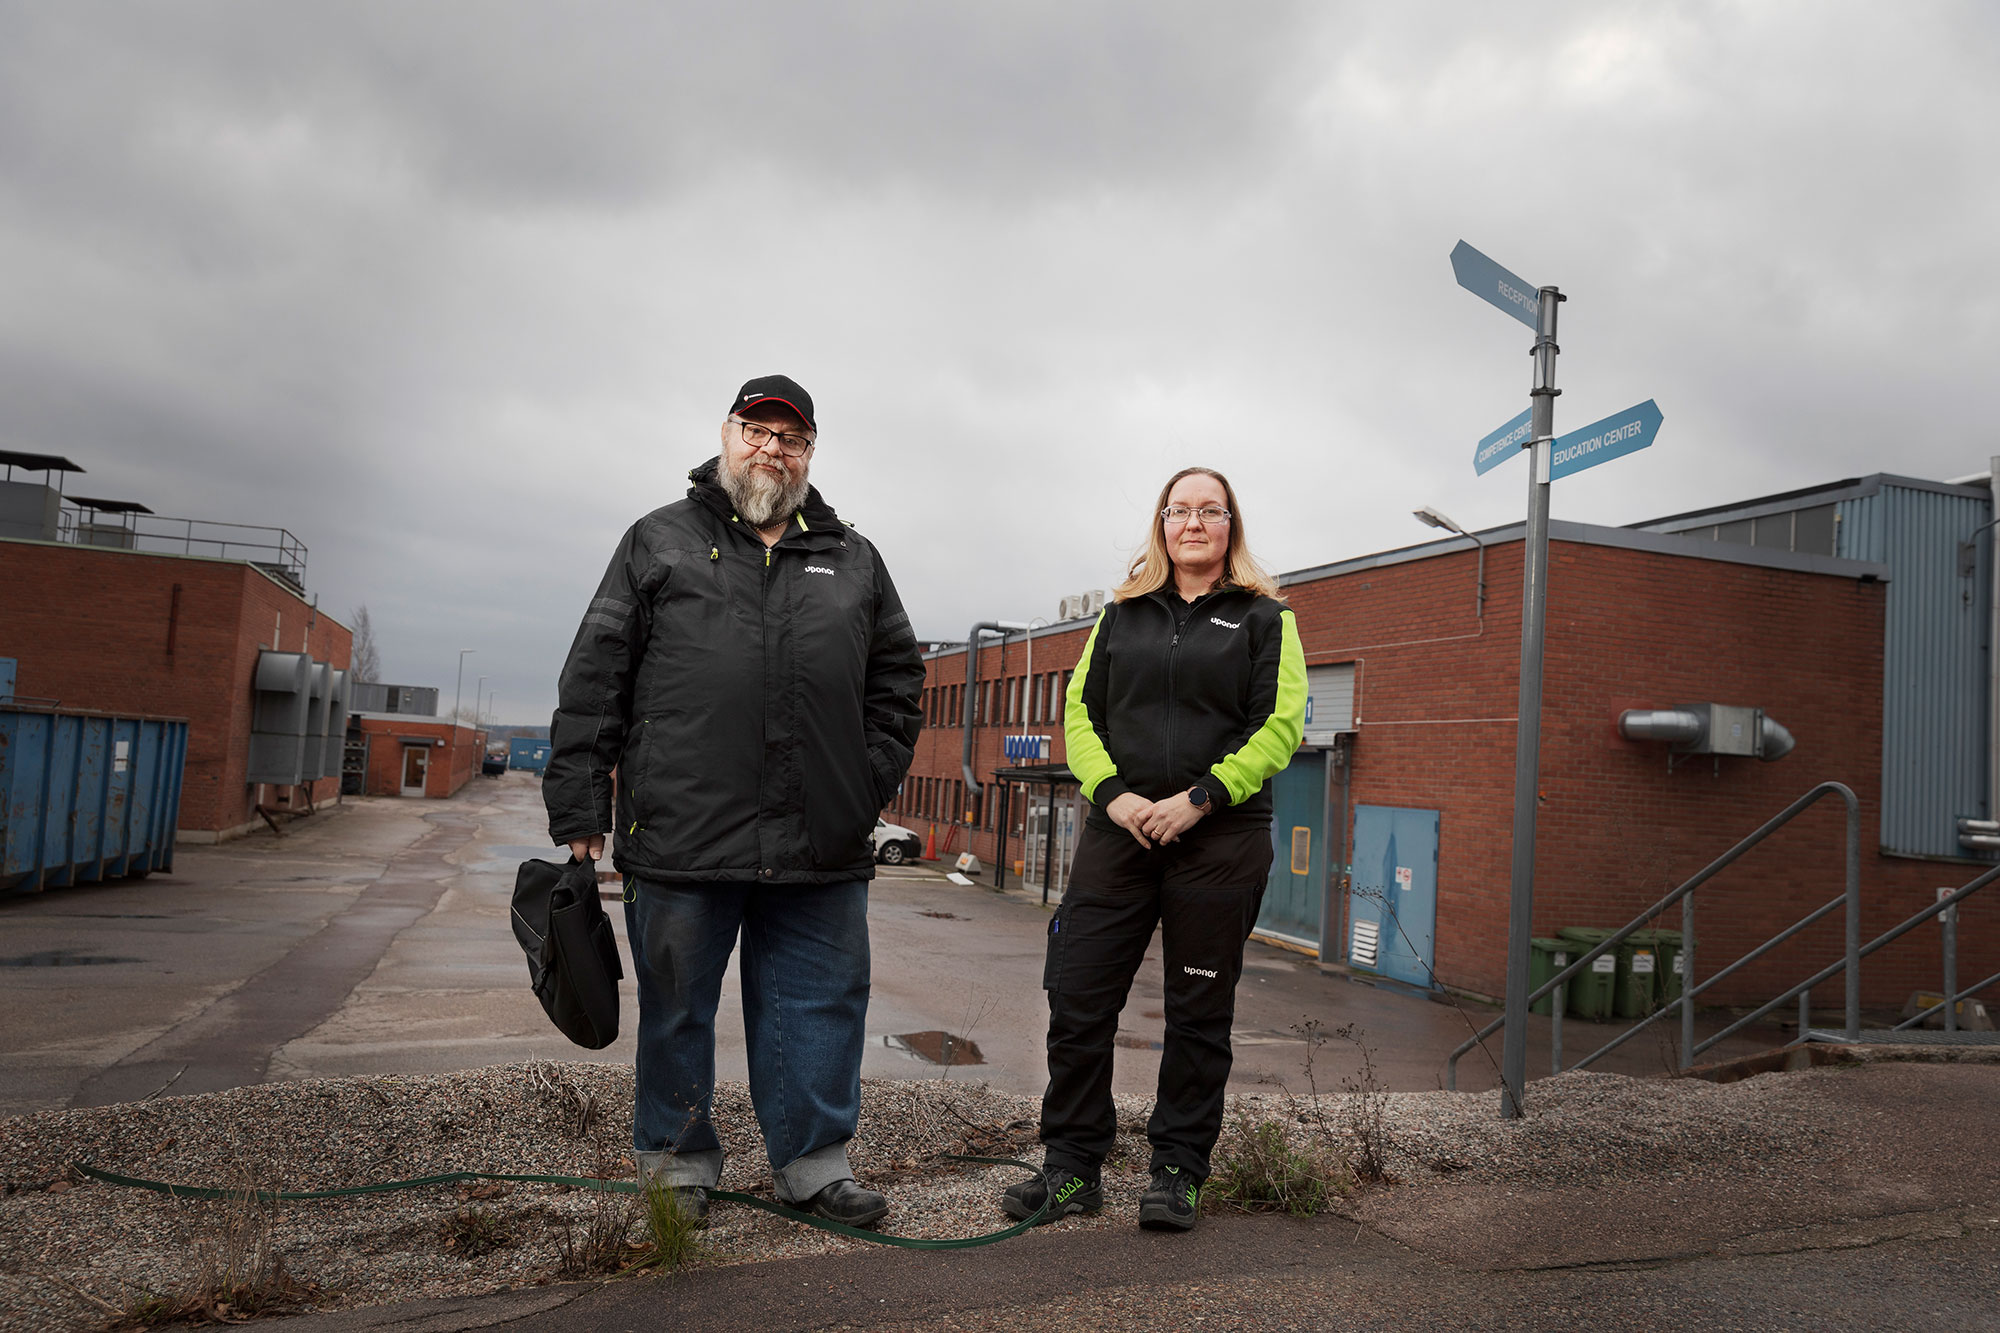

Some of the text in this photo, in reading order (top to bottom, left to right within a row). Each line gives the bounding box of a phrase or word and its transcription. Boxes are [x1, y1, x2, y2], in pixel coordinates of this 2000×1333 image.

[1479, 420, 1532, 463] COMPETENCE CENTE
[1553, 420, 1642, 467] EDUCATION CENTER
[804, 565, 835, 577] uponor
[1210, 617, 1241, 630] uponor
[1004, 735, 1042, 764] uponor
[1184, 965, 1218, 979] uponor
